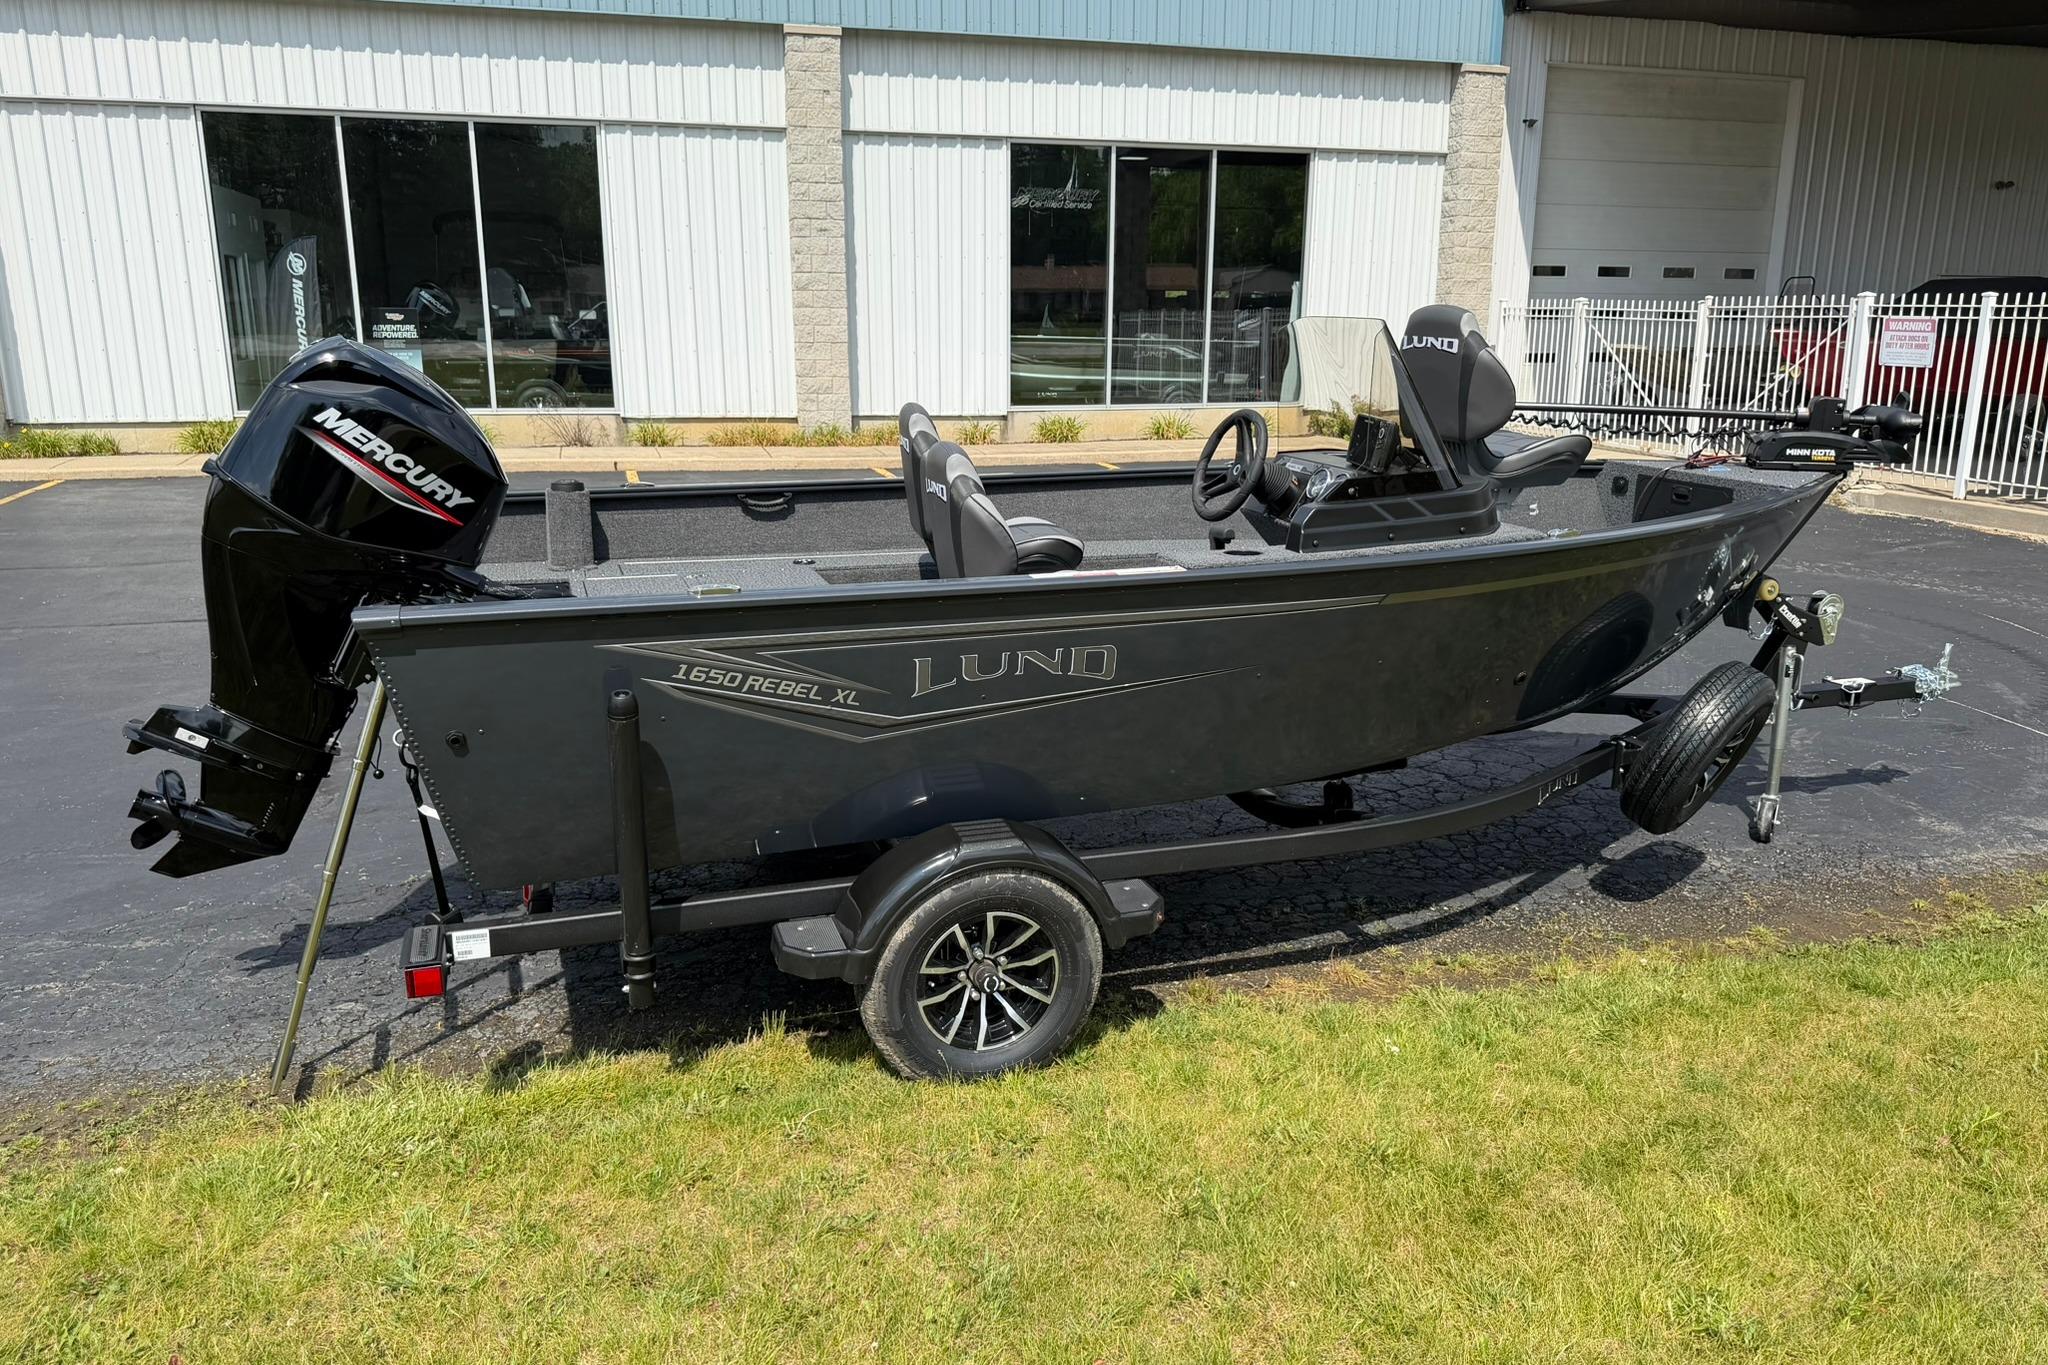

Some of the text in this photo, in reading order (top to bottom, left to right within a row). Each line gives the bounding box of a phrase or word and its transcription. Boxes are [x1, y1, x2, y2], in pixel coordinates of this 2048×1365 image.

[1029, 199, 1093, 209] Certified Service
[420, 290, 452, 314] MERCURY
[292, 278, 309, 352] MERCUR
[372, 324, 417, 332] ADVENTURE,
[372, 331, 419, 339] REPOWERED.
[1889, 321, 1932, 331] WARNING
[1402, 335, 1459, 354] LUND
[1899, 342, 1913, 350] AFTER
[313, 407, 475, 508] MERCURY
[1786, 448, 1836, 457] MINN KOTA
[925, 478, 947, 502] LUND
[911, 645, 1117, 698] LUND
[672, 664, 860, 706] 1650 REBEL XL
